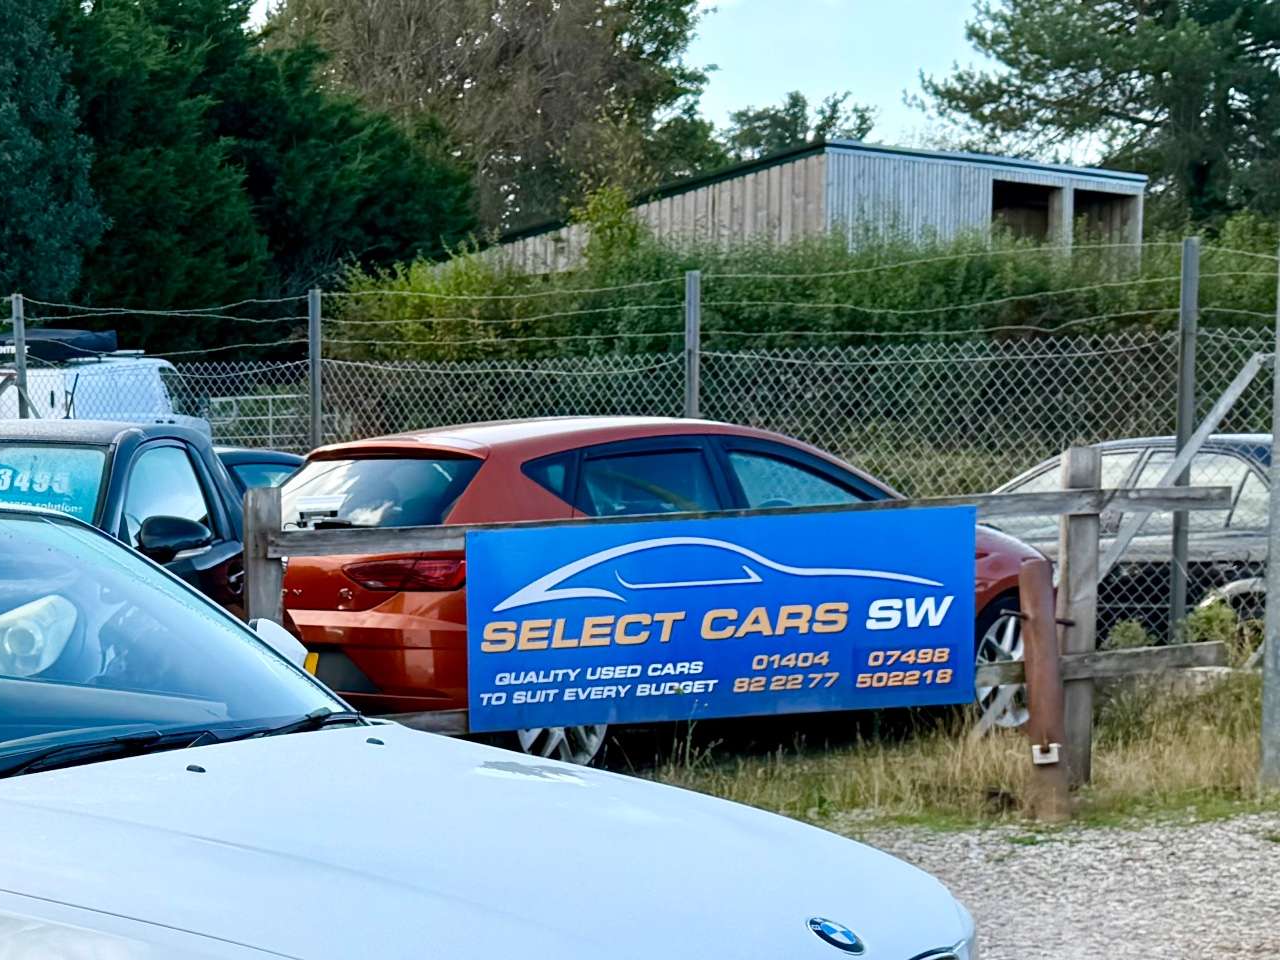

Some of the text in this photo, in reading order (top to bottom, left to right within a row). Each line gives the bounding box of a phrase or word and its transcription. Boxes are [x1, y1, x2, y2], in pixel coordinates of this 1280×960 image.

[480, 595, 956, 653] SELECT CARS SW
[752, 651, 830, 671] 01404
[867, 647, 951, 667] 07498
[494, 661, 704, 686] QUALITY USED CARS
[855, 668, 954, 688] 502218
[479, 679, 719, 706] TO SUIT EVERY BUDGET
